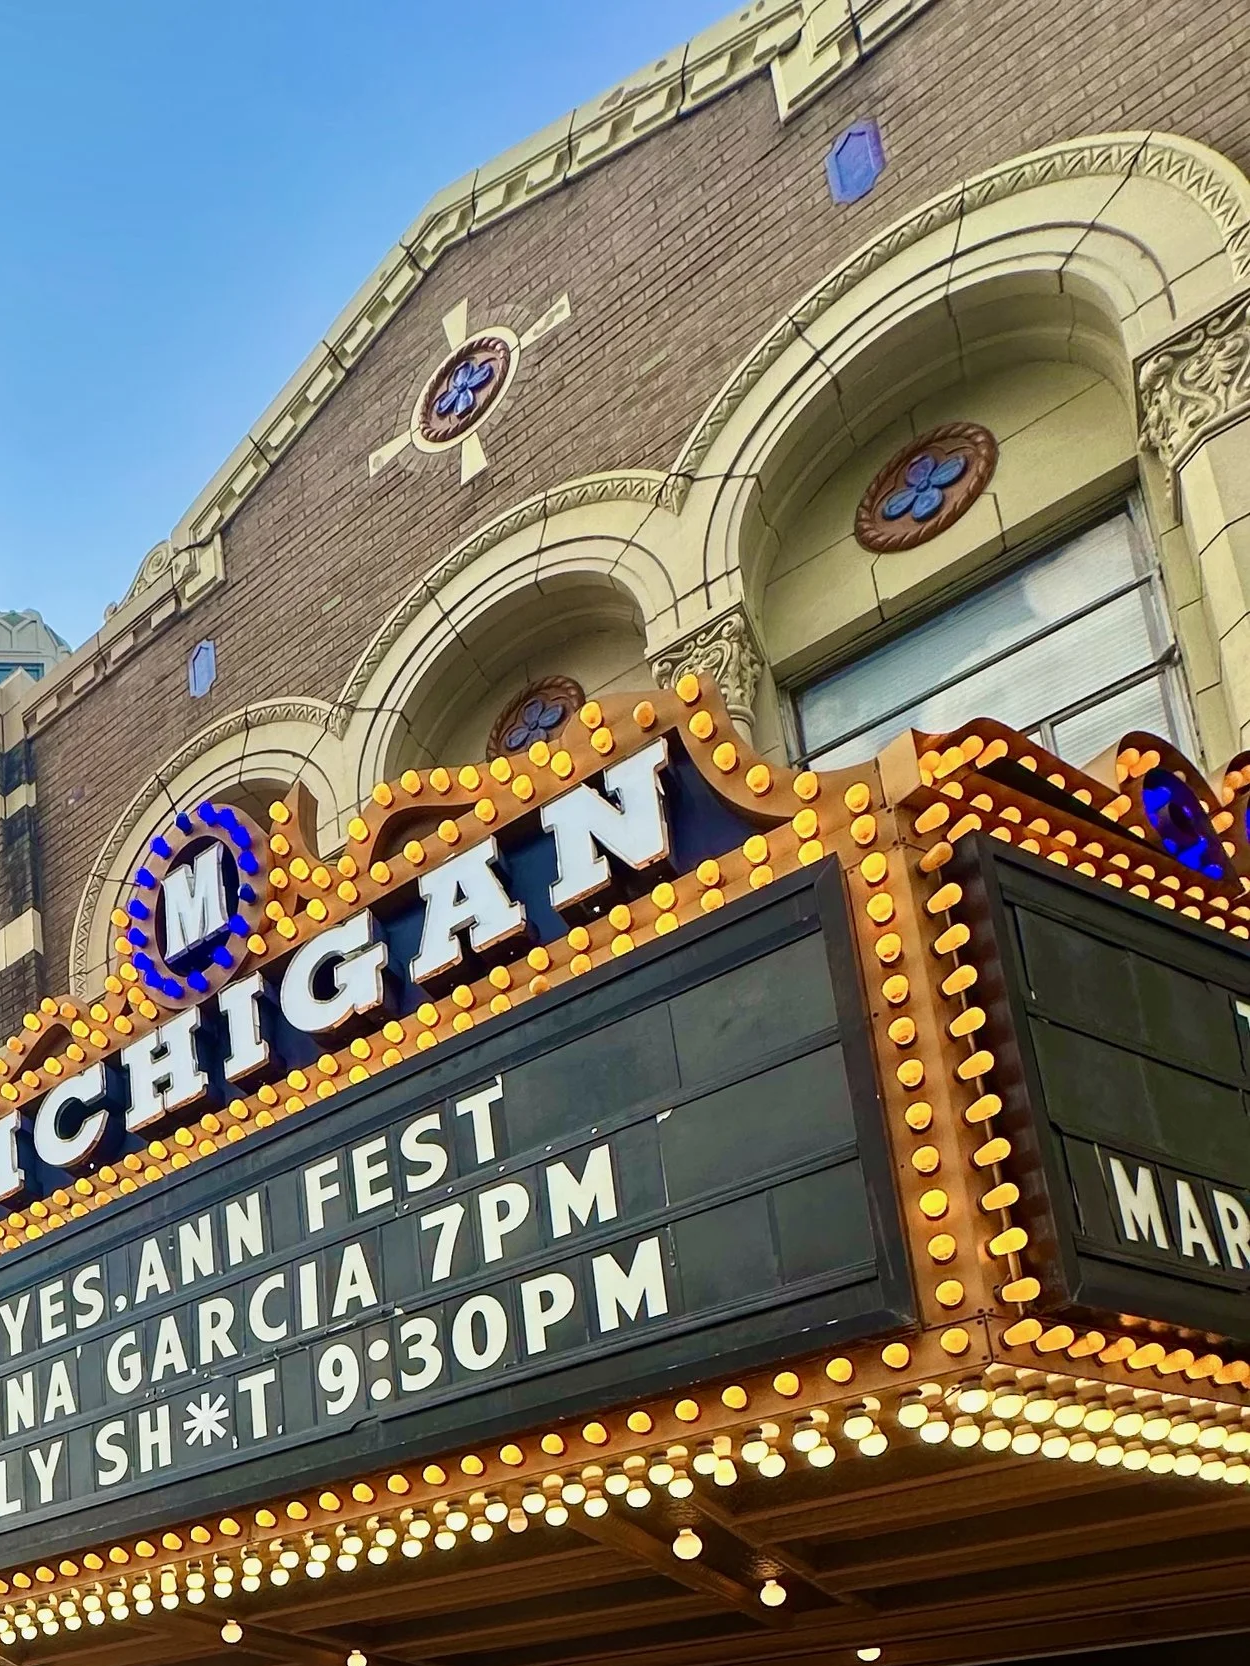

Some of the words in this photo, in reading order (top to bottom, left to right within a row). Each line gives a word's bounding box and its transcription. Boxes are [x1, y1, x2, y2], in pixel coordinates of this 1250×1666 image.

[160, 841, 231, 966] M
[303, 1081, 503, 1234] FEST
[106, 1242, 378, 1395] GARCIA
[420, 1143, 619, 1283] 7PM
[317, 1236, 669, 1417] 9:30PM
